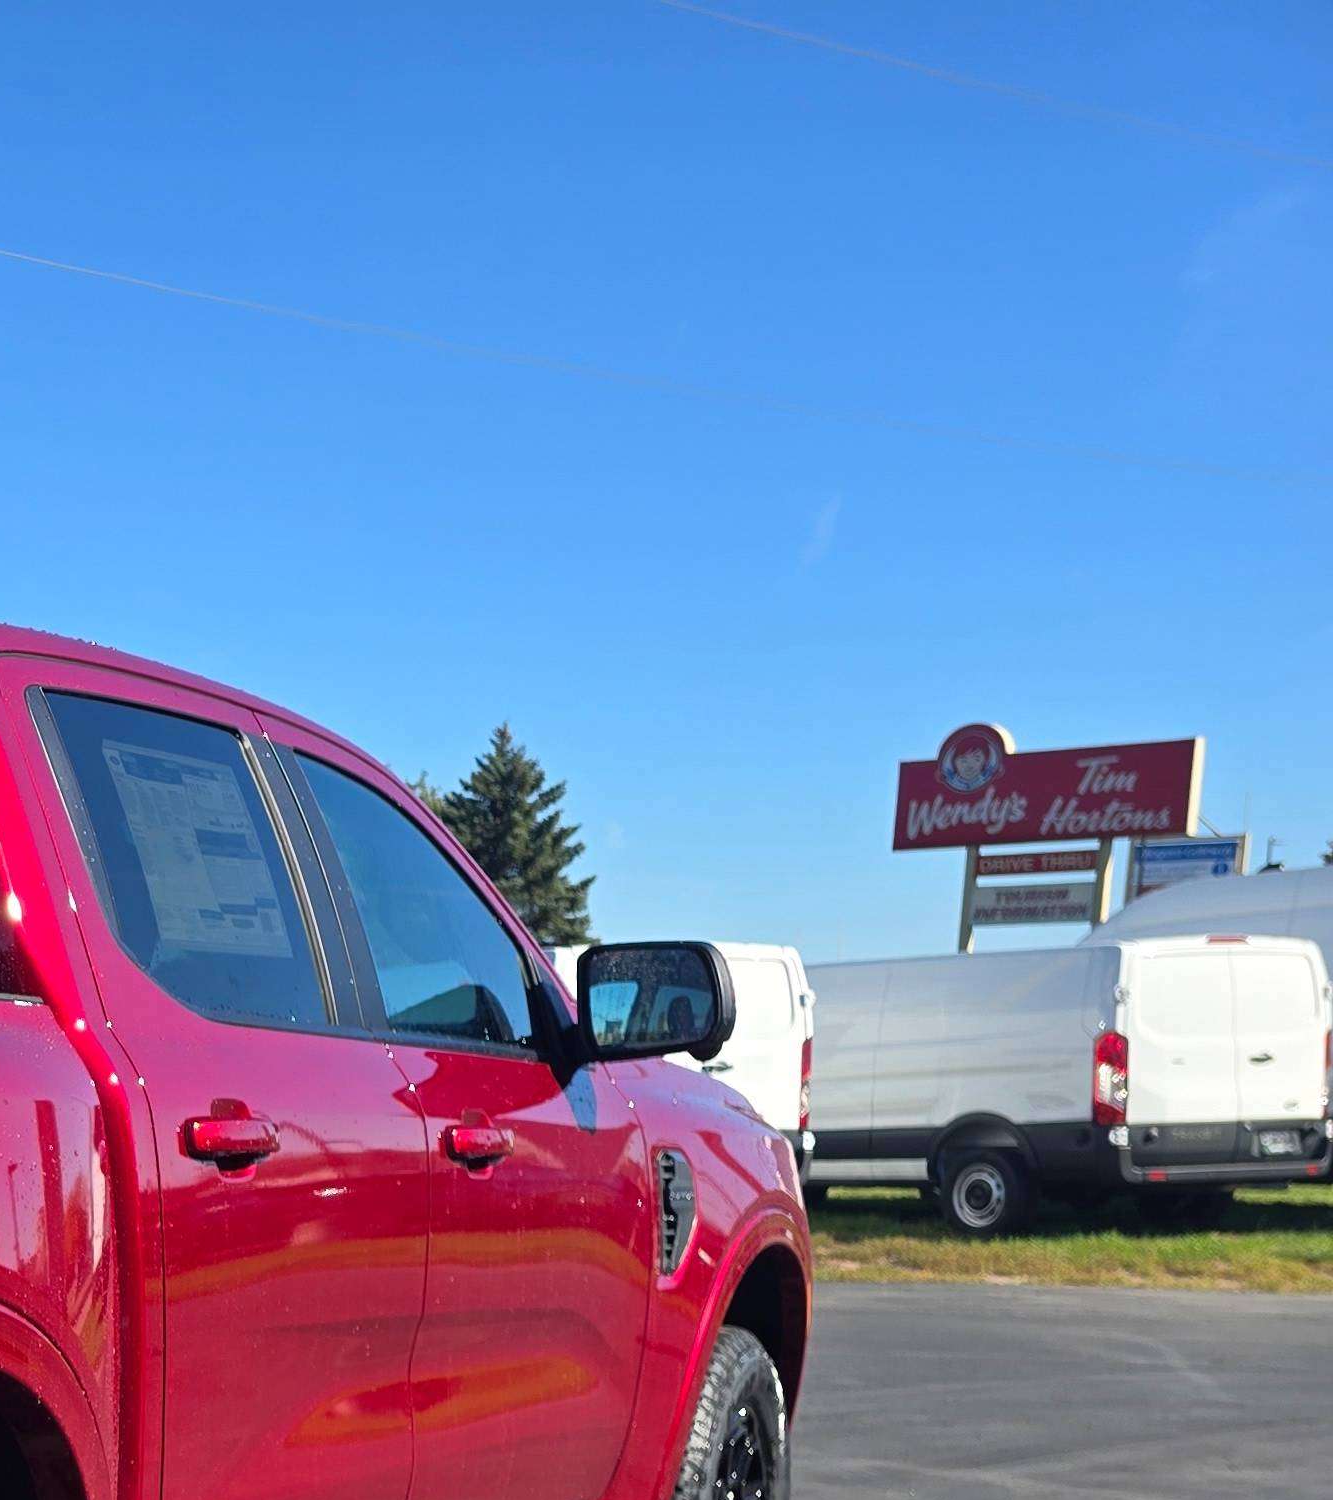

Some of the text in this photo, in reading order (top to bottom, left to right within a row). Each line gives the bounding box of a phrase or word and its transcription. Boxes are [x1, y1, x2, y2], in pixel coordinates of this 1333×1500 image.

[1076, 755, 1139, 796] Tim
[906, 785, 1029, 841] Wendy's
[1040, 795, 1172, 837] Hortons
[978, 856, 1034, 874] DRIVE
